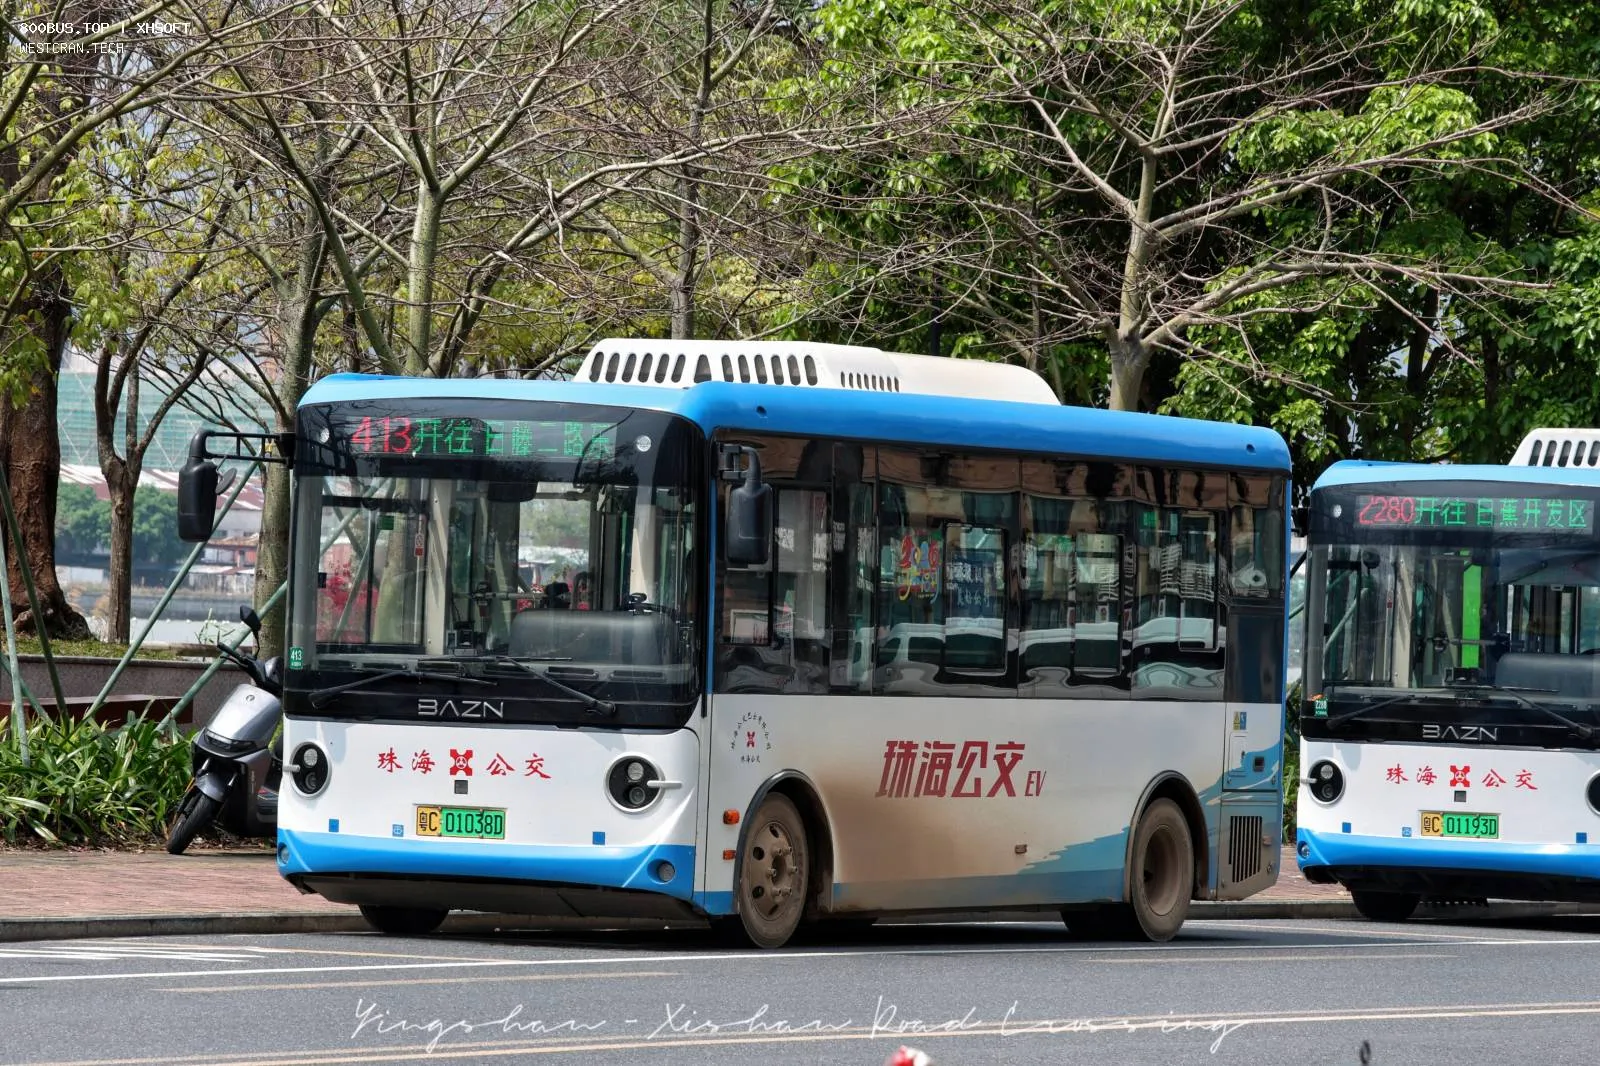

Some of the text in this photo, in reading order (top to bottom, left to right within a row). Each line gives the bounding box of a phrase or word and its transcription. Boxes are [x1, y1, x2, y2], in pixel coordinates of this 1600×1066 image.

[351, 416, 412, 453] 413
[1415, 497, 1467, 526] 开往
[417, 698, 504, 718] BAZN
[1422, 724, 1498, 741] BAZN
[377, 747, 552, 779] 珠海 公交
[875, 740, 1047, 798] 珠海公交 EV
[1386, 763, 1538, 790] 珠海 公交
[445, 812, 503, 835] 01038D
[1446, 817, 1497, 836] 01193D
